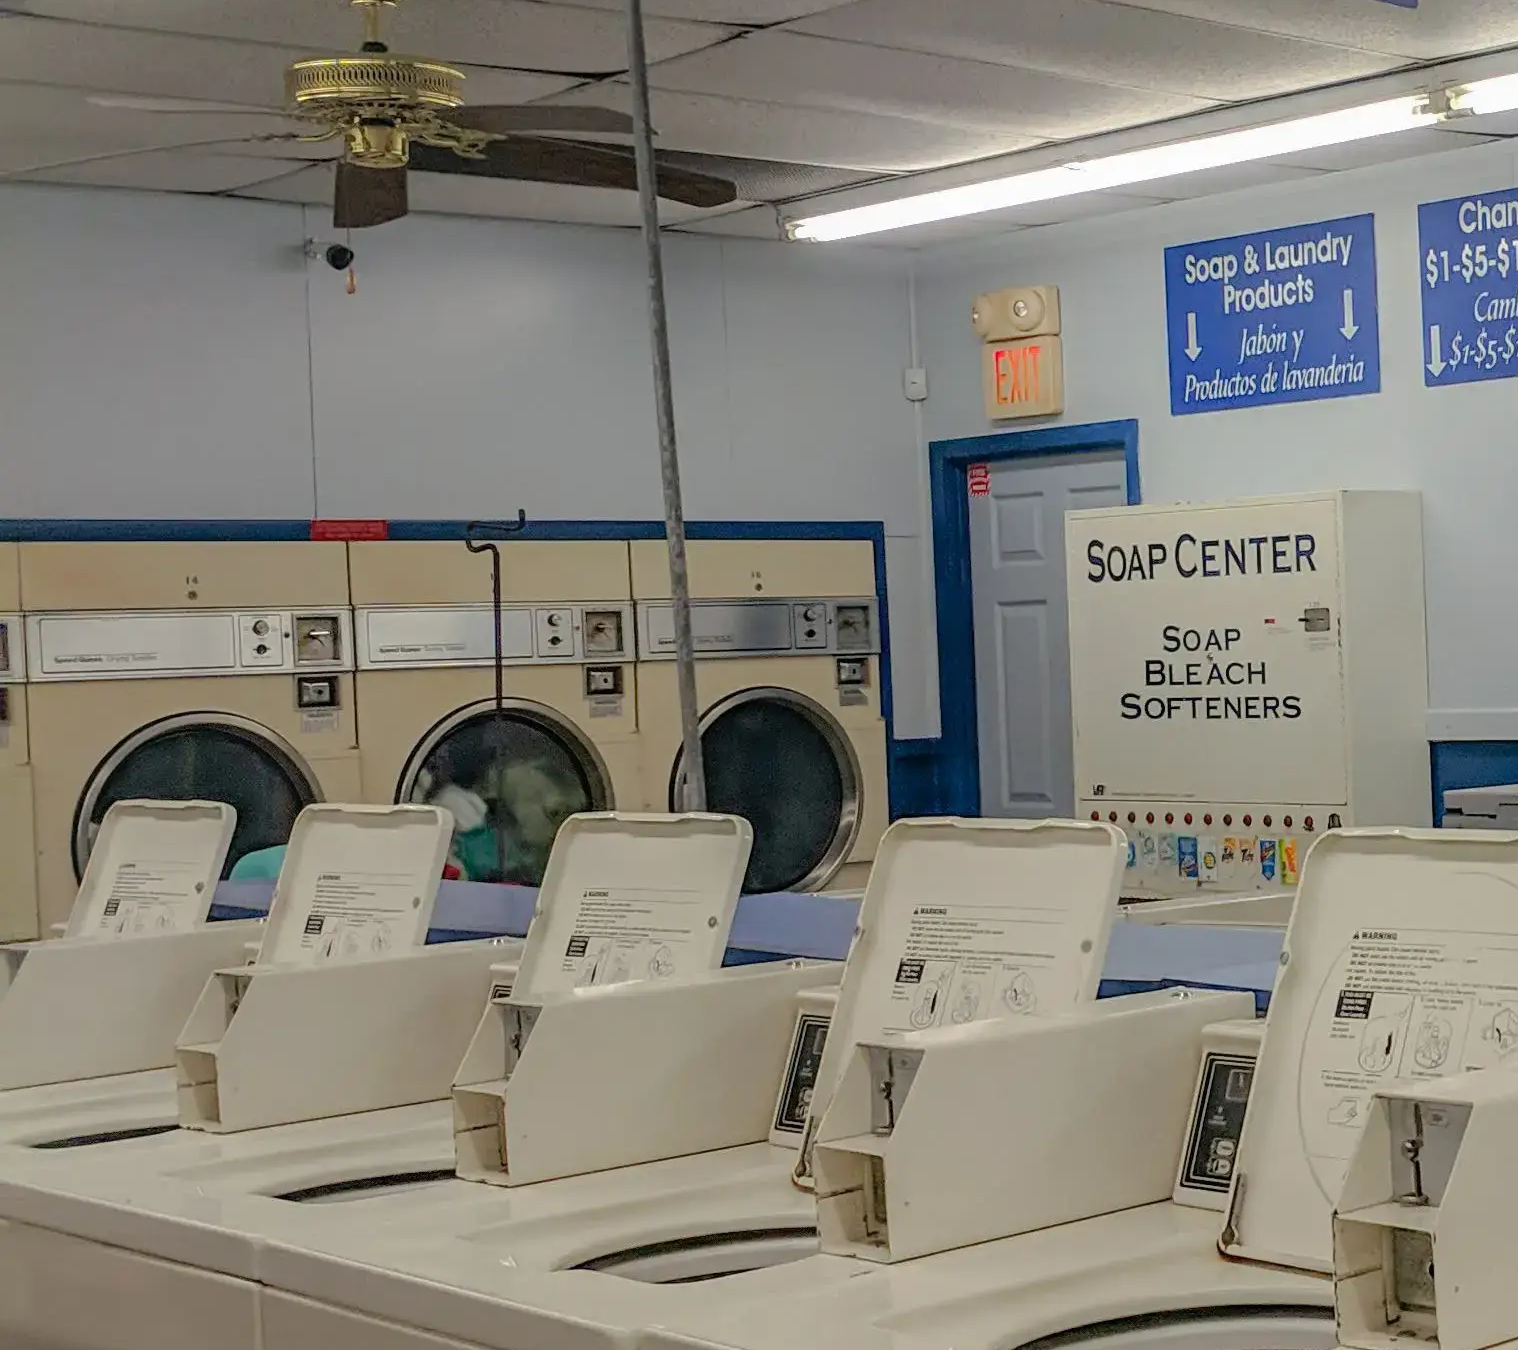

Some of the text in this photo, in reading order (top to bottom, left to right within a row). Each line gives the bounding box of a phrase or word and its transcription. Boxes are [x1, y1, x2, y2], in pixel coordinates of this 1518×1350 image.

[1184, 233, 1353, 285] Soap & Laundry
[1224, 274, 1314, 314] Products
[1238, 323, 1304, 364] Jabón y
[993, 346, 1041, 404] EXIT
[1184, 368, 1257, 403] Productos
[1261, 362, 1279, 393] de
[1087, 532, 1317, 582] SOAP CENTER
[185, 575, 198, 585] 14
[1162, 625, 1241, 653] SOAP
[1145, 659, 1267, 687] BLEACH
[1120, 692, 1302, 721] SOFTENERS
